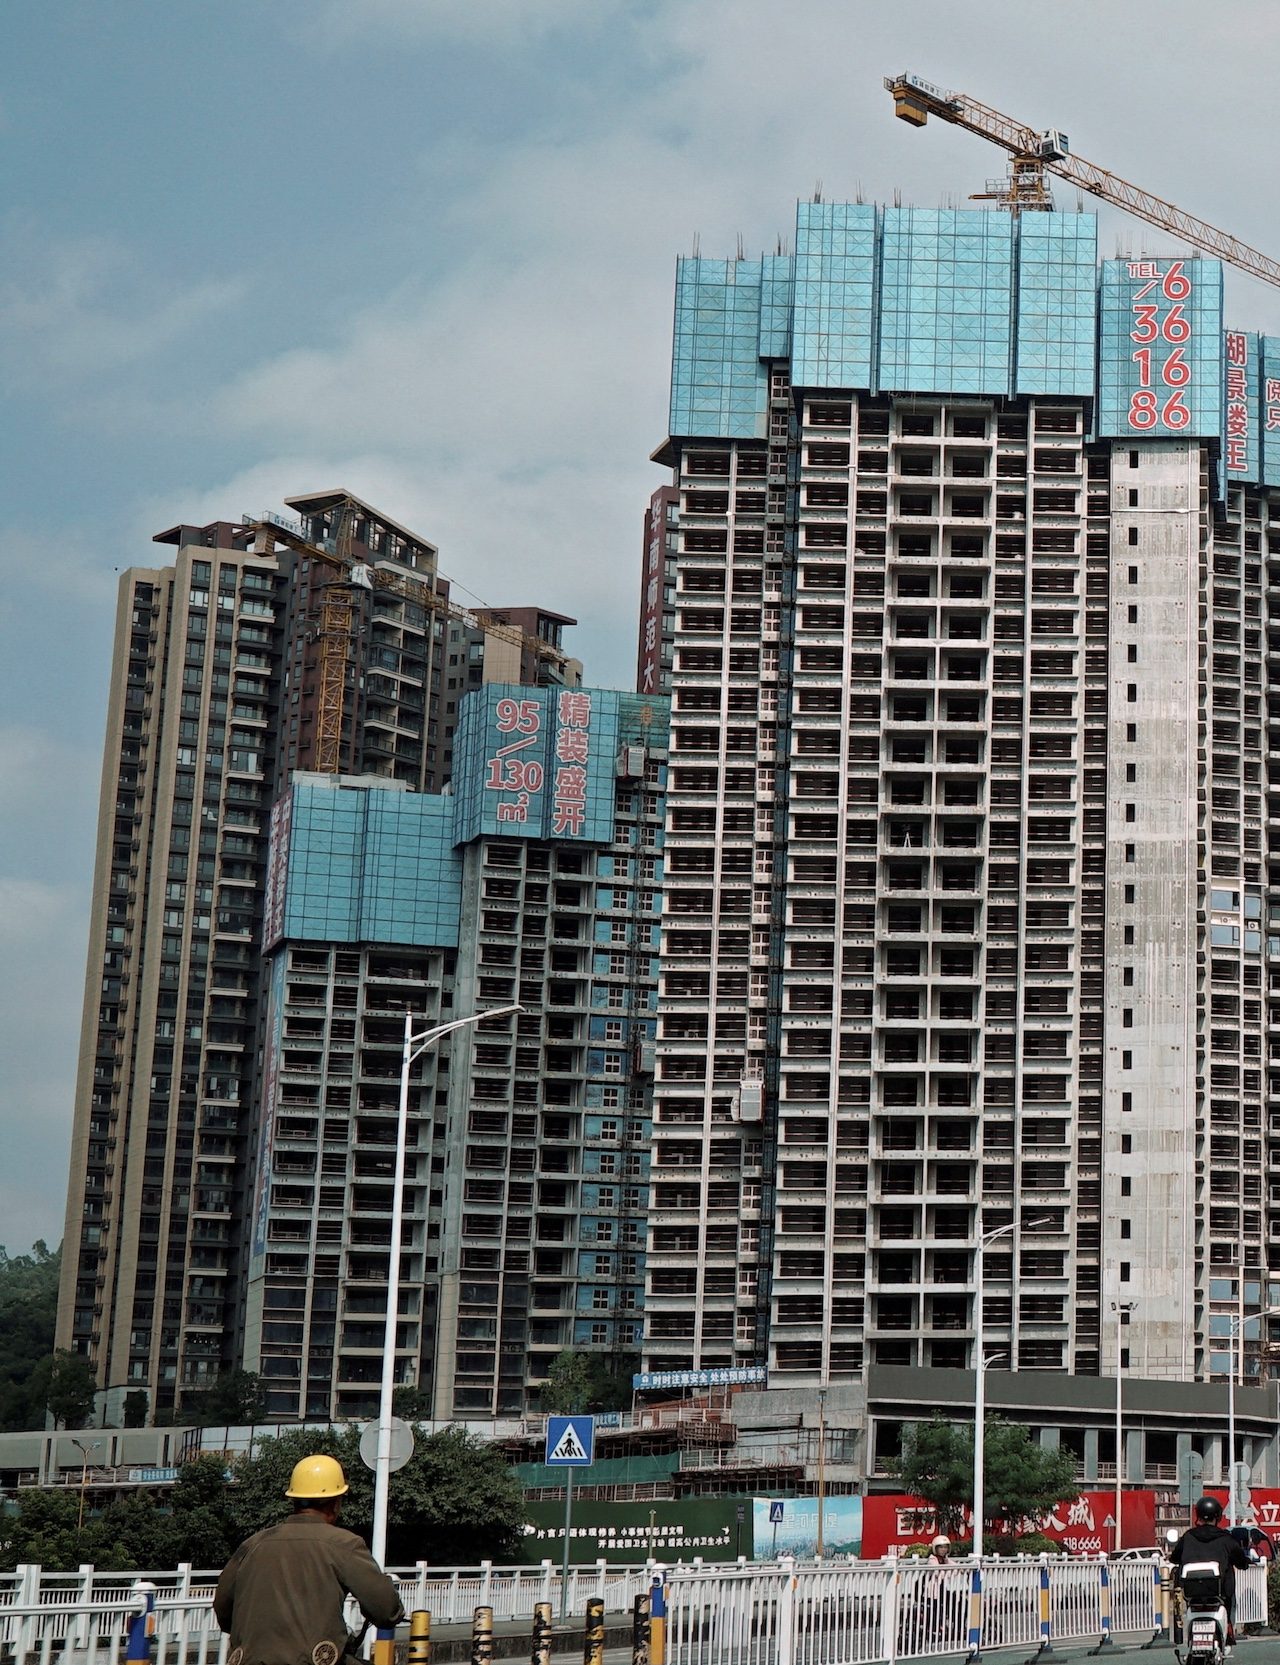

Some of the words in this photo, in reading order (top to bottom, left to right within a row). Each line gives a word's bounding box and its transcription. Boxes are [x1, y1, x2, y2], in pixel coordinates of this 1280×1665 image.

[1127, 262, 1162, 279] TEL
[496, 699, 540, 734] 95
[486, 758, 544, 793] 130
[553, 691, 591, 836] 精装盛开
